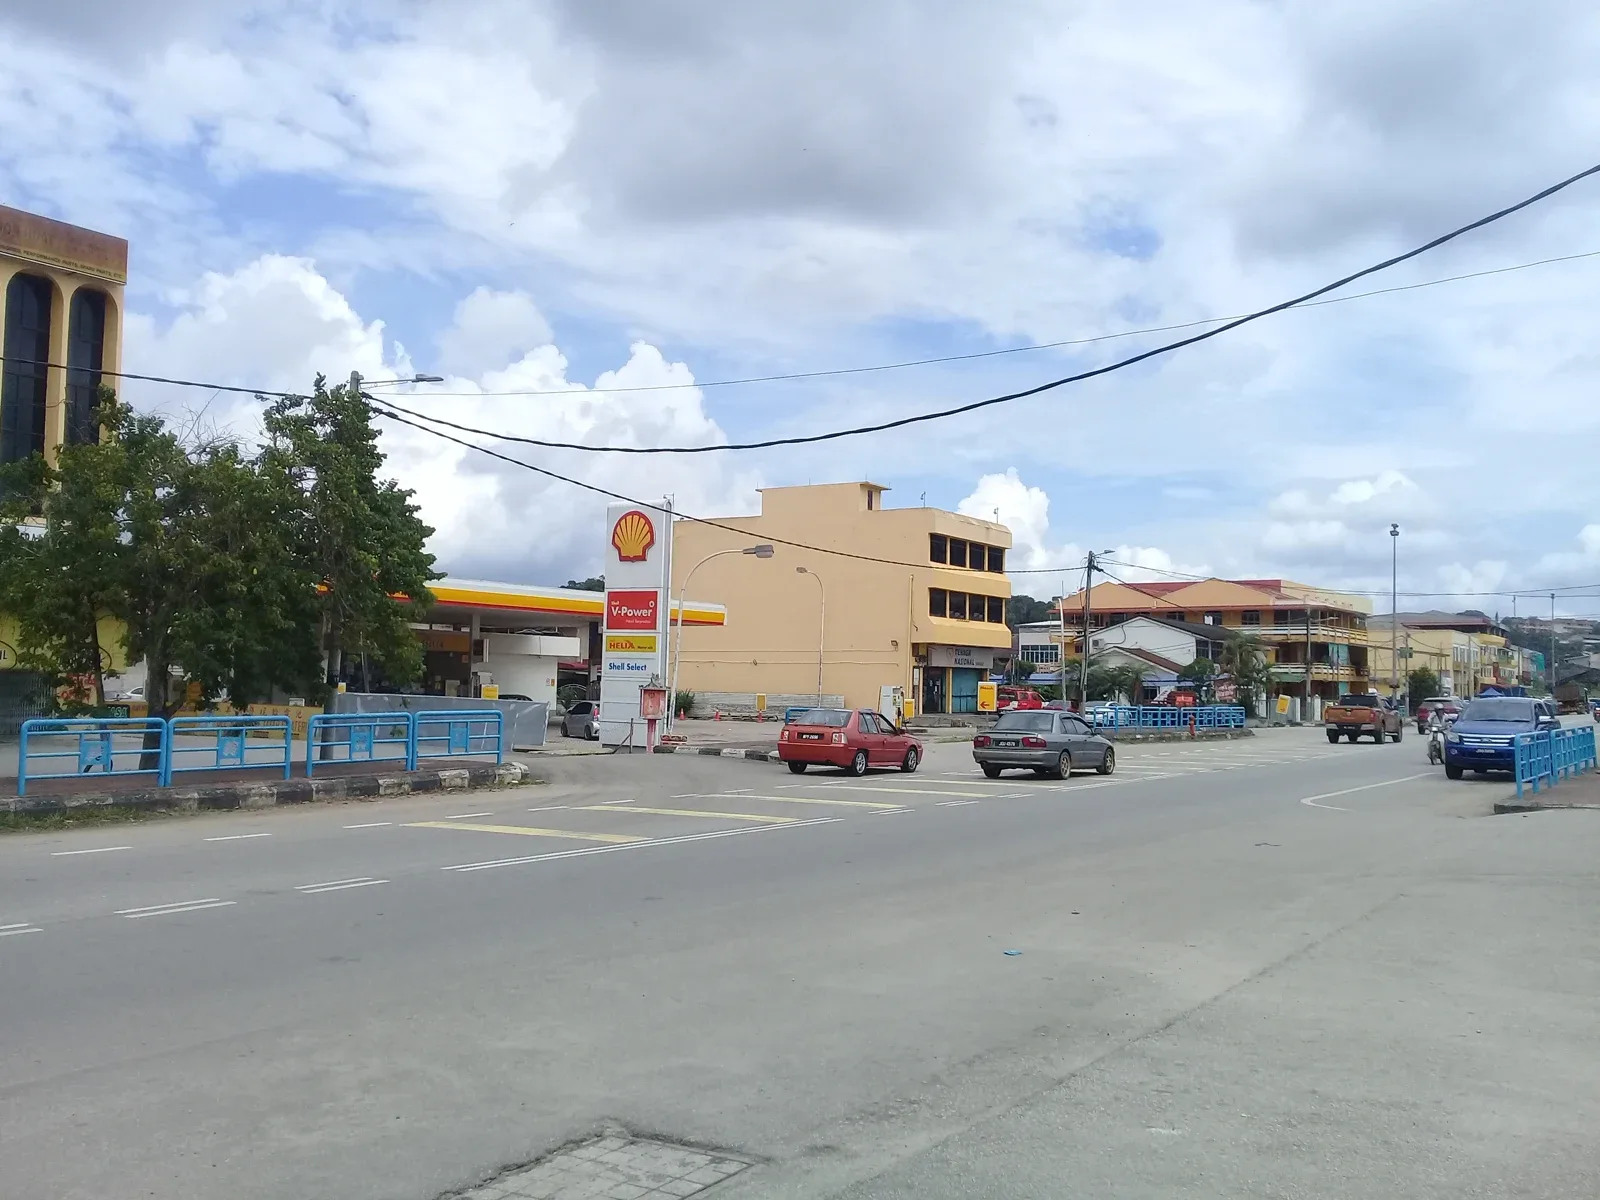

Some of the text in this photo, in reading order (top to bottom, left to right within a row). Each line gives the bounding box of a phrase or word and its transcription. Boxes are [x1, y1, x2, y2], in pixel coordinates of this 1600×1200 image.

[611, 606, 652, 617] V-Power
[609, 640, 636, 650] HELIX
[608, 662, 647, 671] Shell Select
